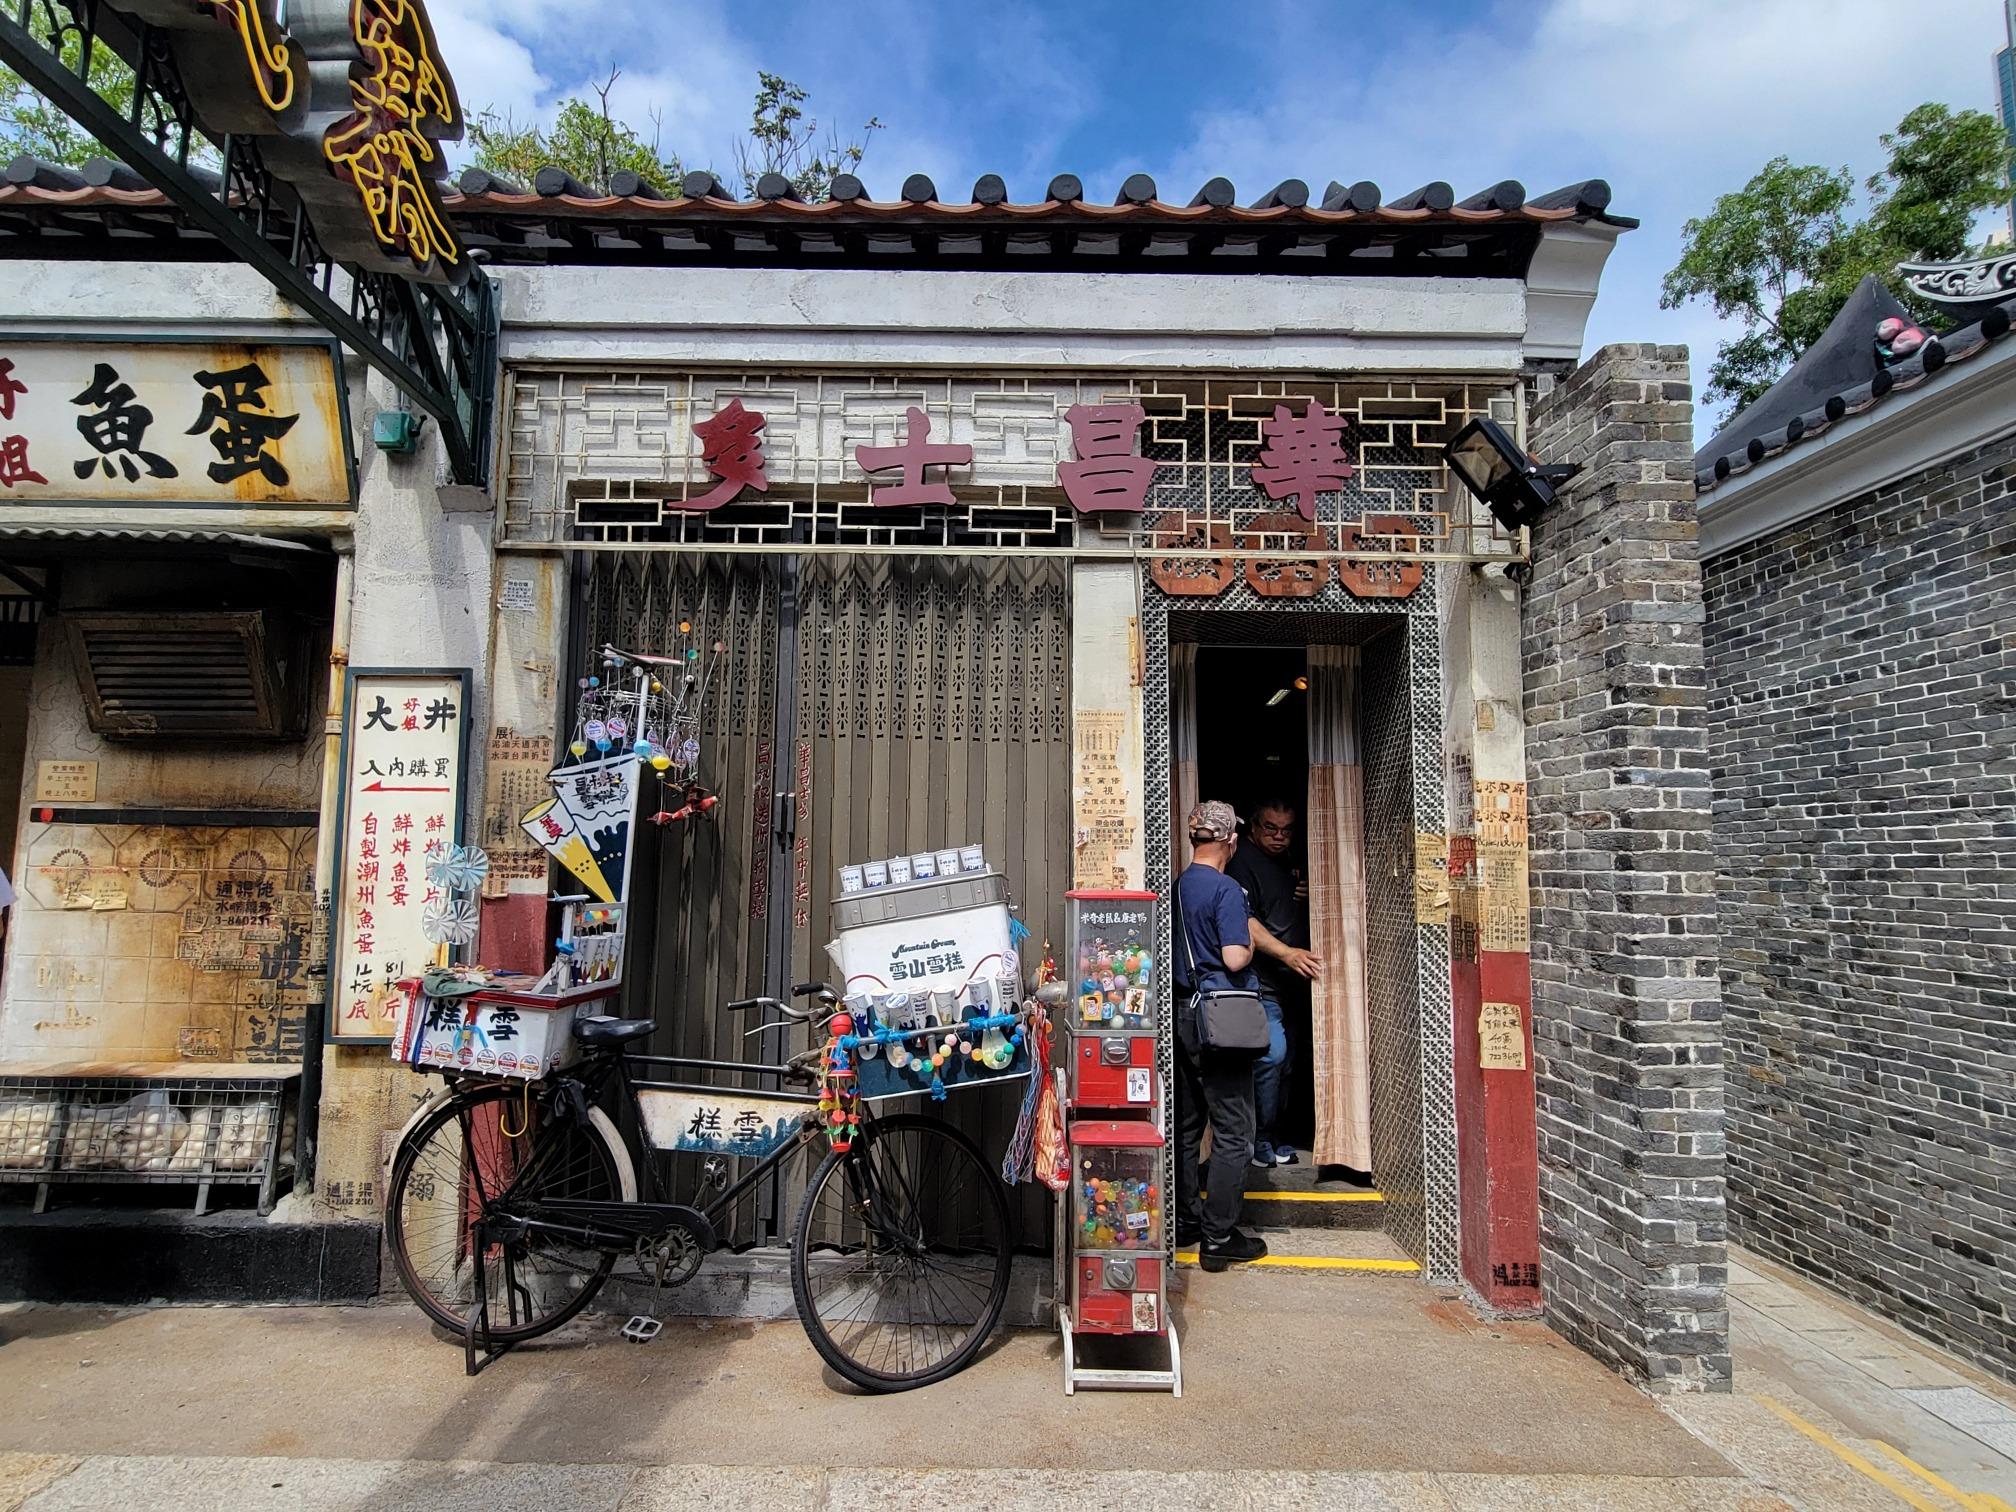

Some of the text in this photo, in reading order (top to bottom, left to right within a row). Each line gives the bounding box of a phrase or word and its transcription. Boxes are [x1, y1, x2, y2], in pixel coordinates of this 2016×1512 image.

[69, 363, 300, 487] 魚蛋
[360, 757, 450, 778] 入內購買
[354, 811, 380, 955] 自製潮州魚蛋
[386, 813, 414, 906] 鮮炸魚蛋
[889, 950, 965, 981] 雪山雪糕
[892, 944, 930, 959] Mountain
